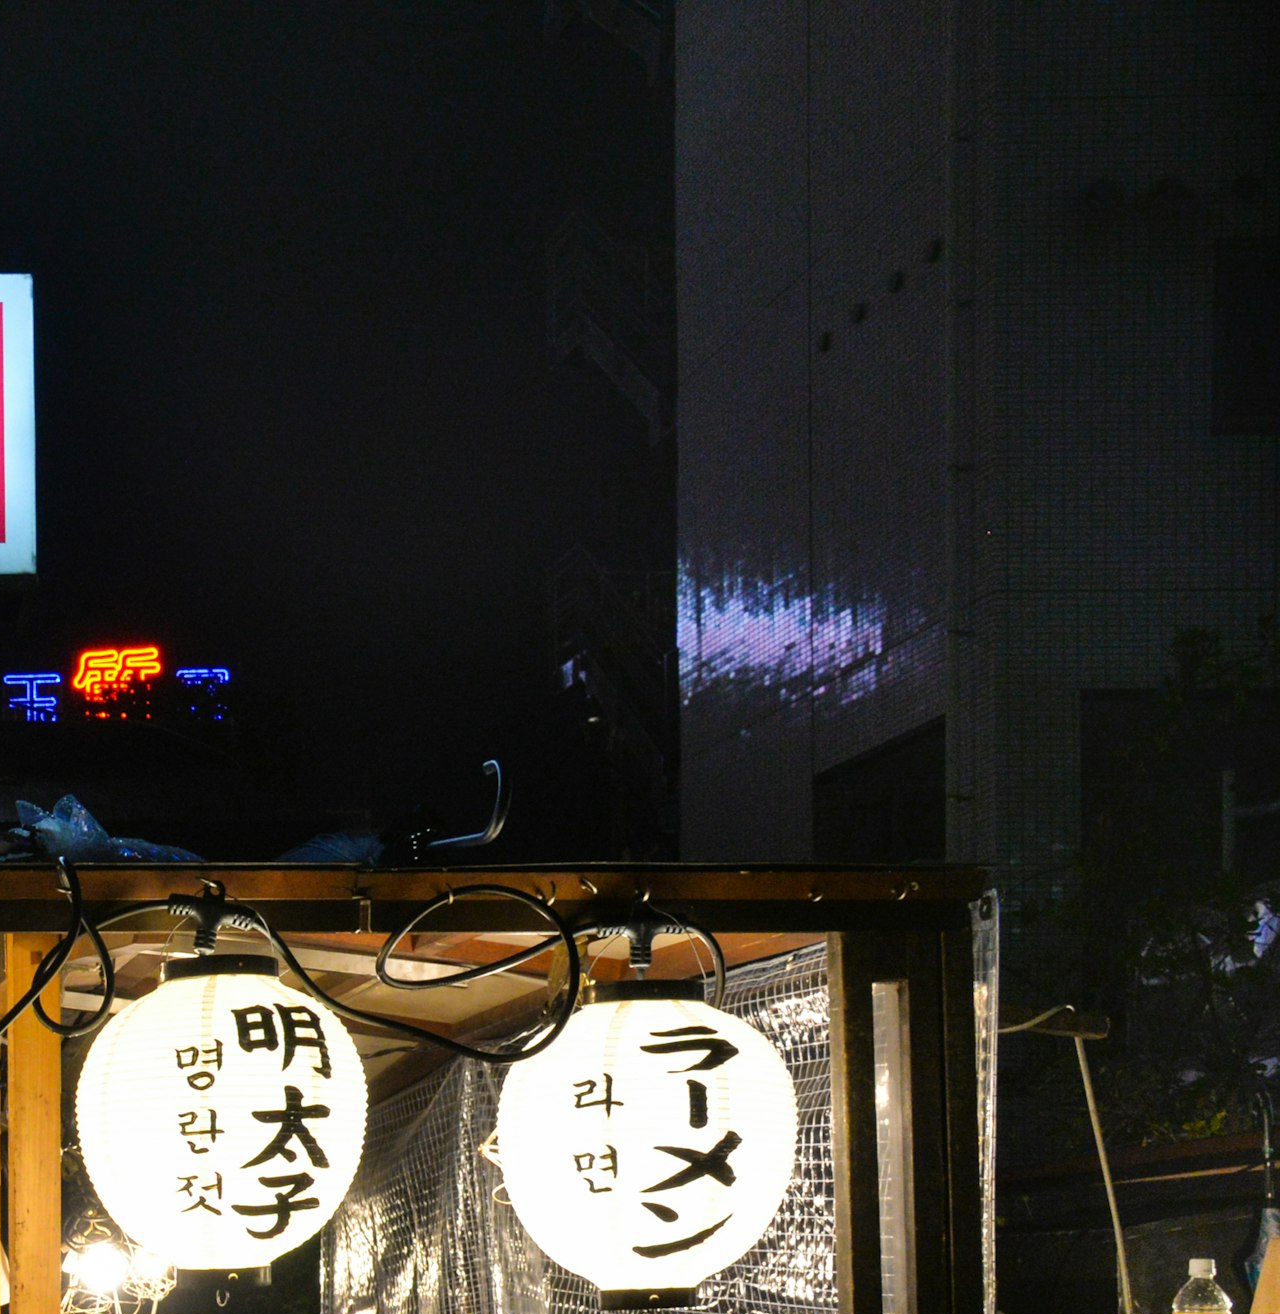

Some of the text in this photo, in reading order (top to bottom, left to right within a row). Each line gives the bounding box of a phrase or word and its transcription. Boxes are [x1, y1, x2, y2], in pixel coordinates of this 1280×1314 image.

[176, 1039, 225, 1215] 명란젓
[231, 1003, 332, 1239] 明太子
[573, 1074, 624, 1193] 라면
[633, 1026, 743, 1259] ラーメン
